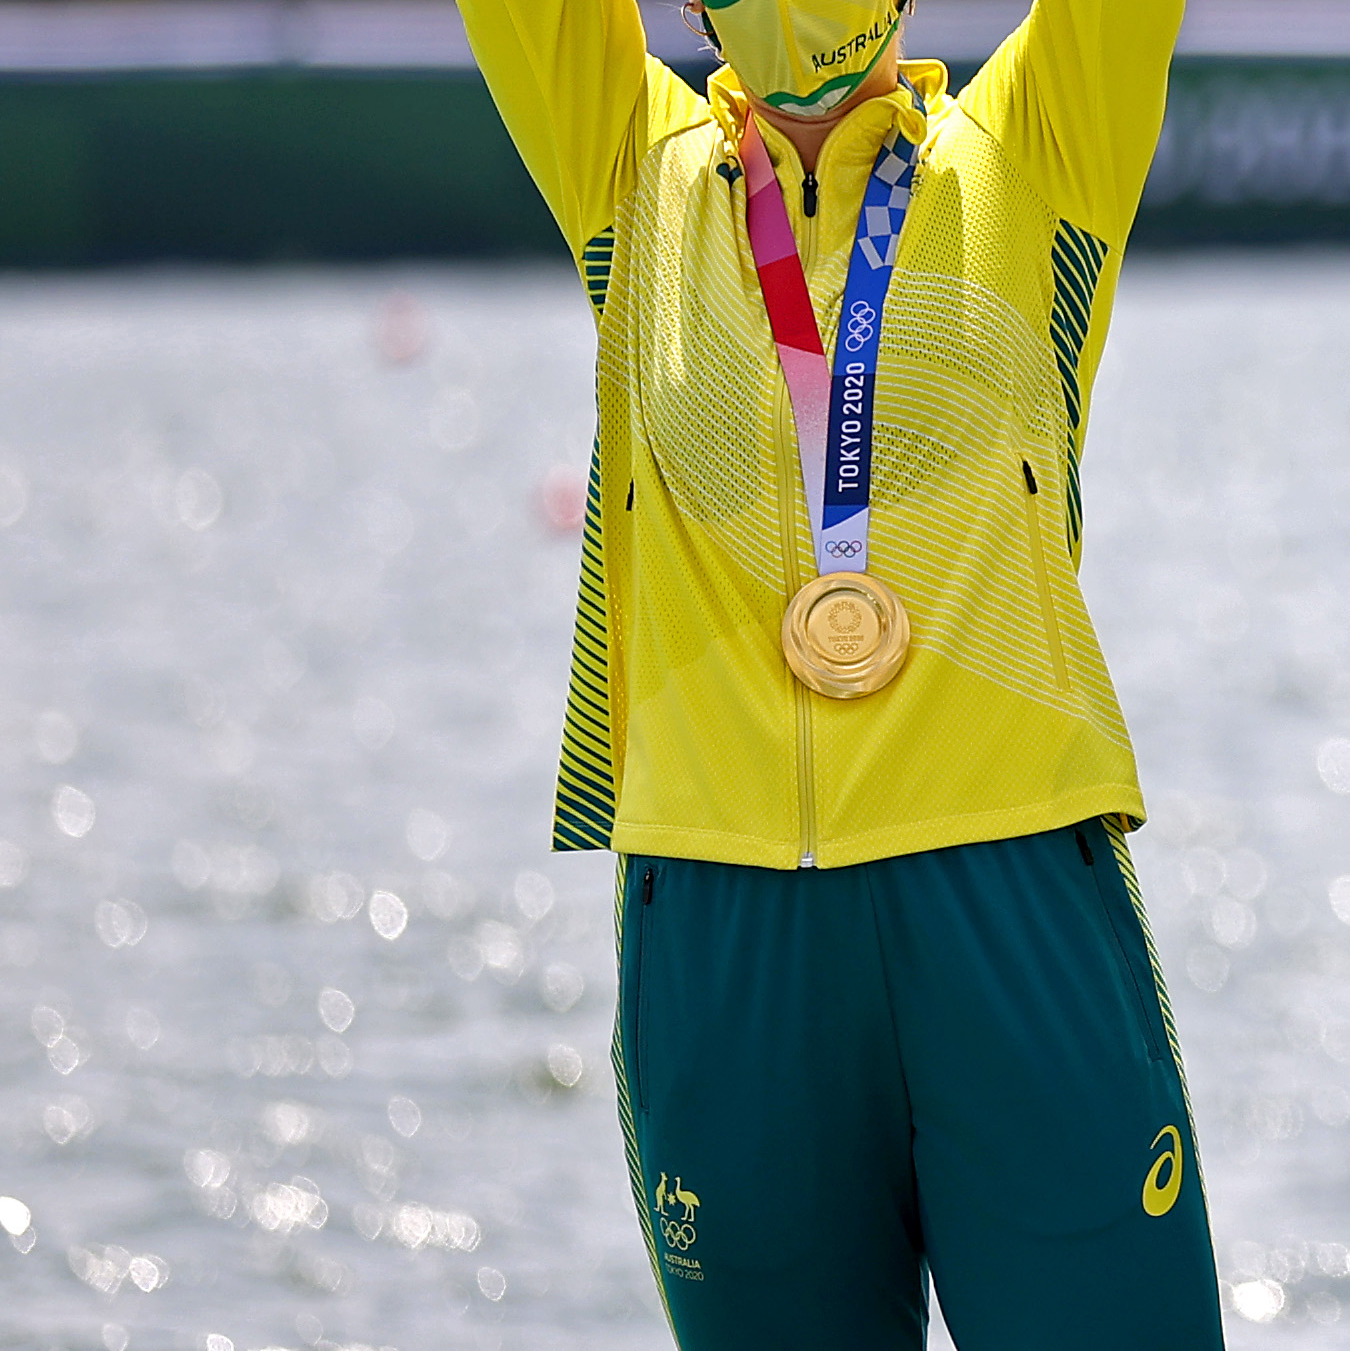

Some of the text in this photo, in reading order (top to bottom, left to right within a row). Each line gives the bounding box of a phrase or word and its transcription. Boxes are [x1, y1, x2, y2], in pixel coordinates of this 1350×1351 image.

[838, 362, 866, 493] TOKYO 2020
[664, 1252, 702, 1269] AUSTRALIA
[685, 1270, 704, 1281] 2020
